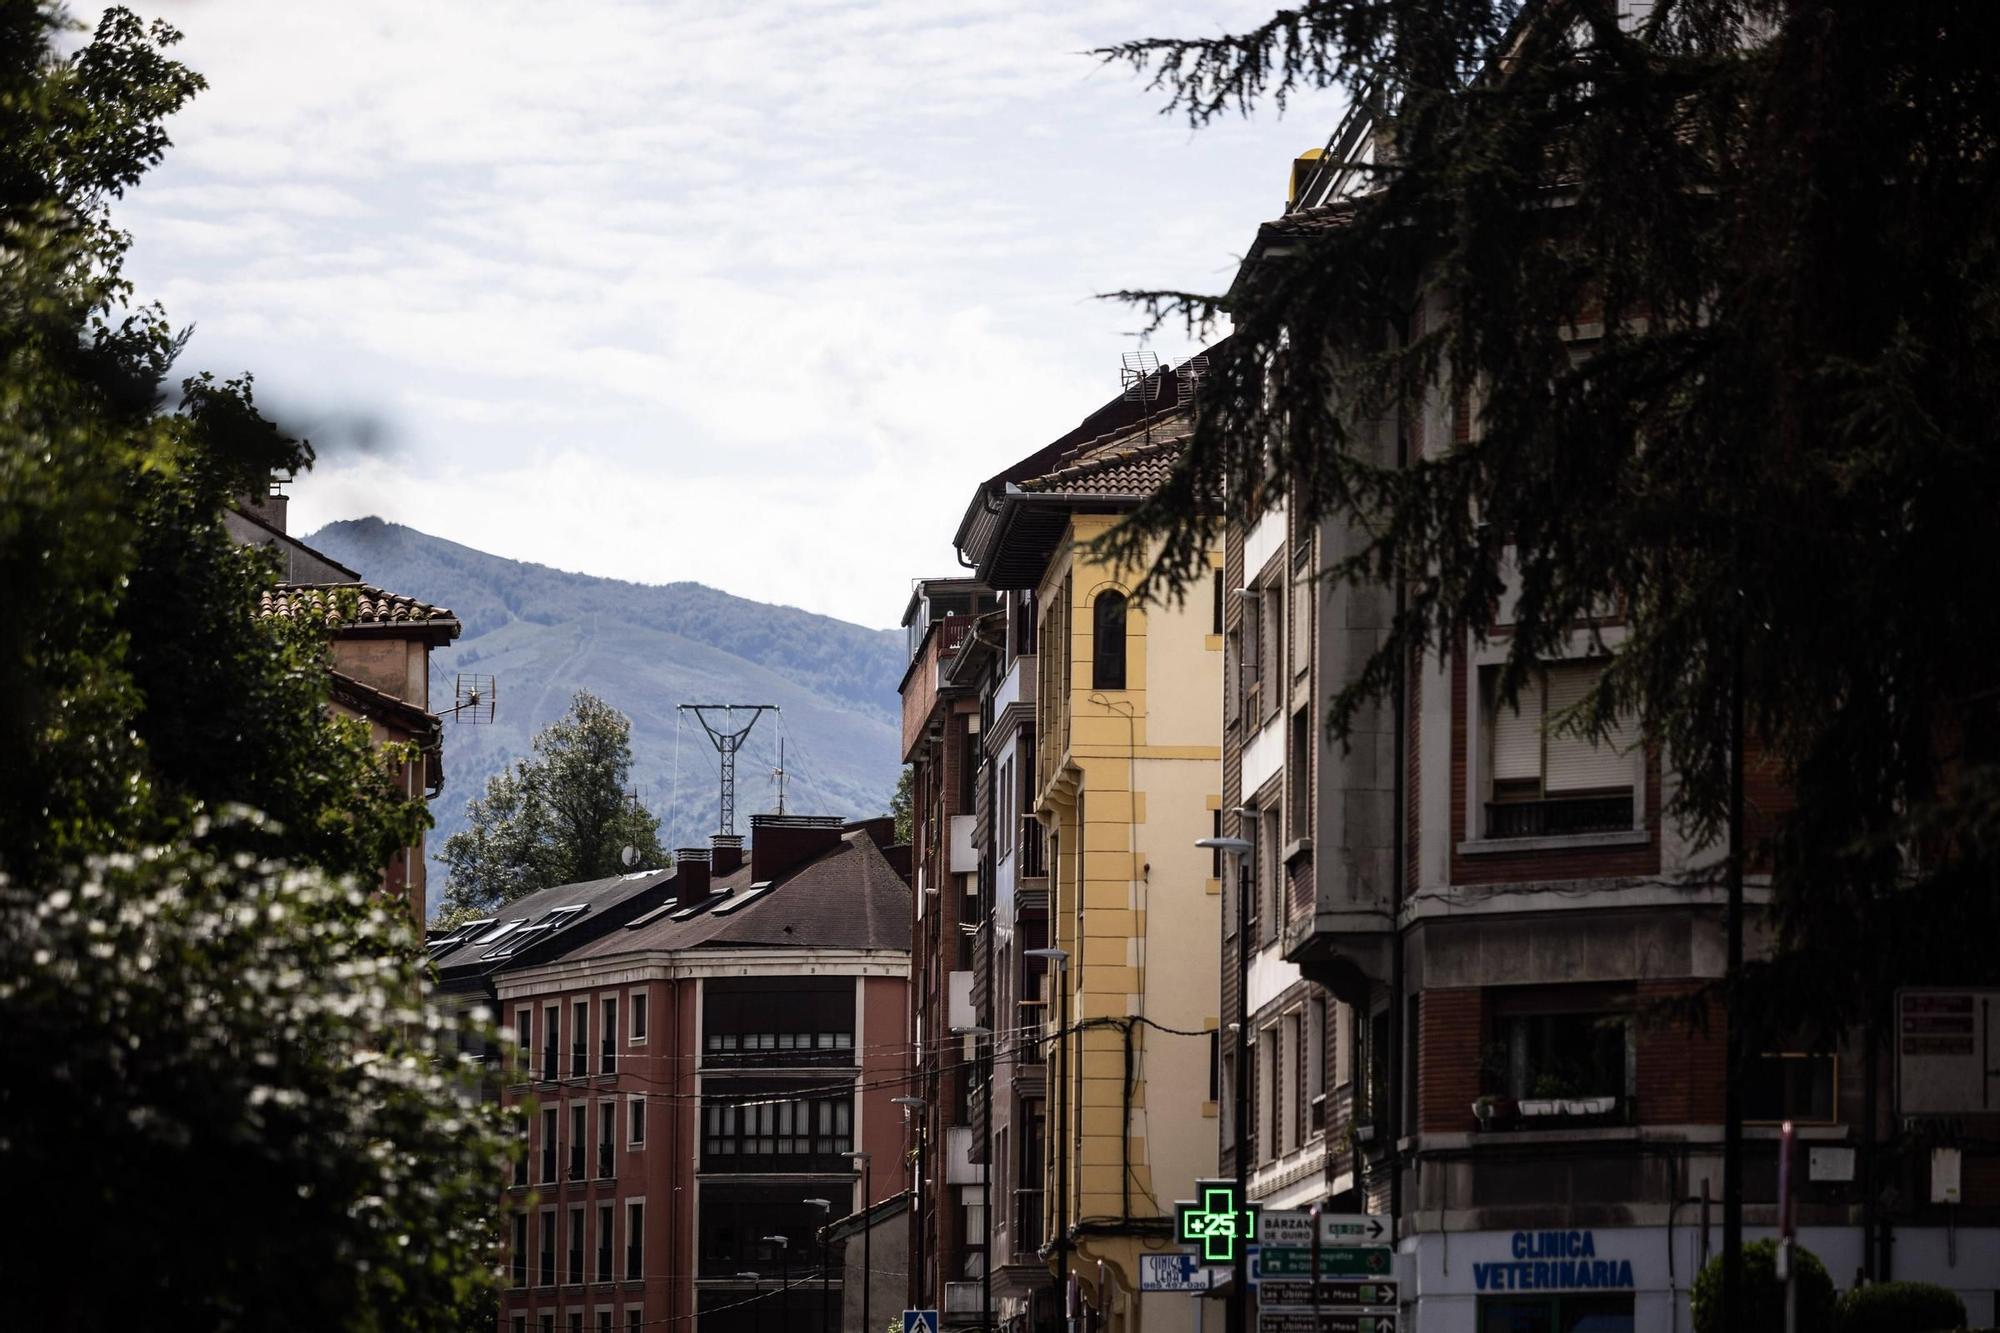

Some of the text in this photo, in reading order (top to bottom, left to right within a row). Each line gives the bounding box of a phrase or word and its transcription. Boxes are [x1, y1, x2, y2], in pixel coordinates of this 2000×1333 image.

[1264, 1217, 1313, 1230] BÁRZAN
[1264, 1231, 1276, 1240] DE
[1511, 1230, 1595, 1259] CLINICA
[1472, 1259, 1634, 1290] VETERINARIA
[1333, 1289, 1358, 1299] Mesa
[1332, 1321, 1357, 1331] Mesa
